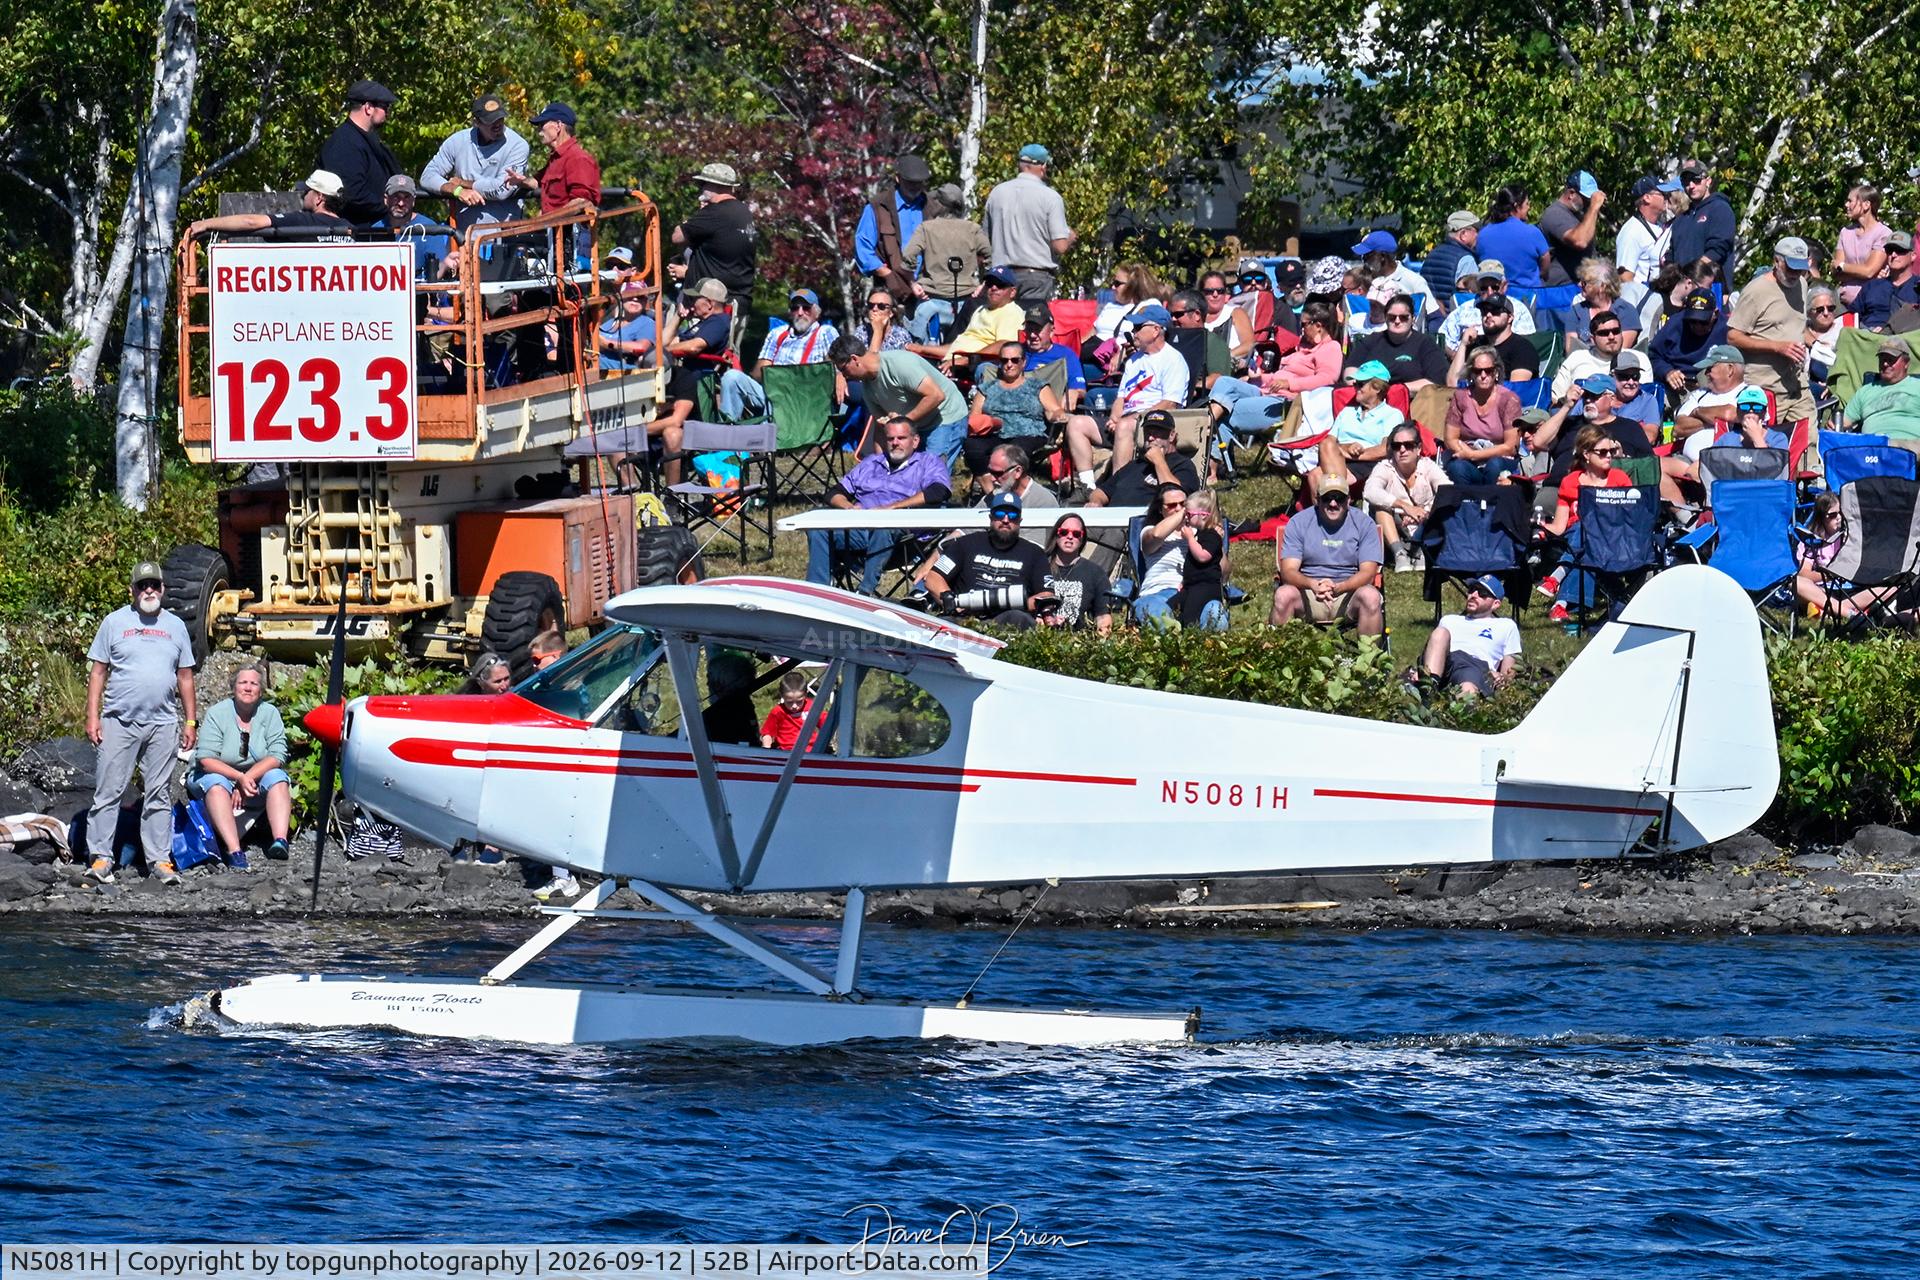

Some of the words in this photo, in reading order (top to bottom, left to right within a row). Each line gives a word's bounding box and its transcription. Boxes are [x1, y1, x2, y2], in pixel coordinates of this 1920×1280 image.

[217, 265, 406, 293] REGISTRATION
[233, 321, 335, 342] SEAPLANE
[342, 321, 394, 342] BASE
[217, 357, 409, 442] 123.3
[420, 475, 440, 497] JLG
[1162, 780, 1288, 810] N5081H
[351, 991, 425, 1001] Baumann
[431, 993, 483, 1004] Floats
